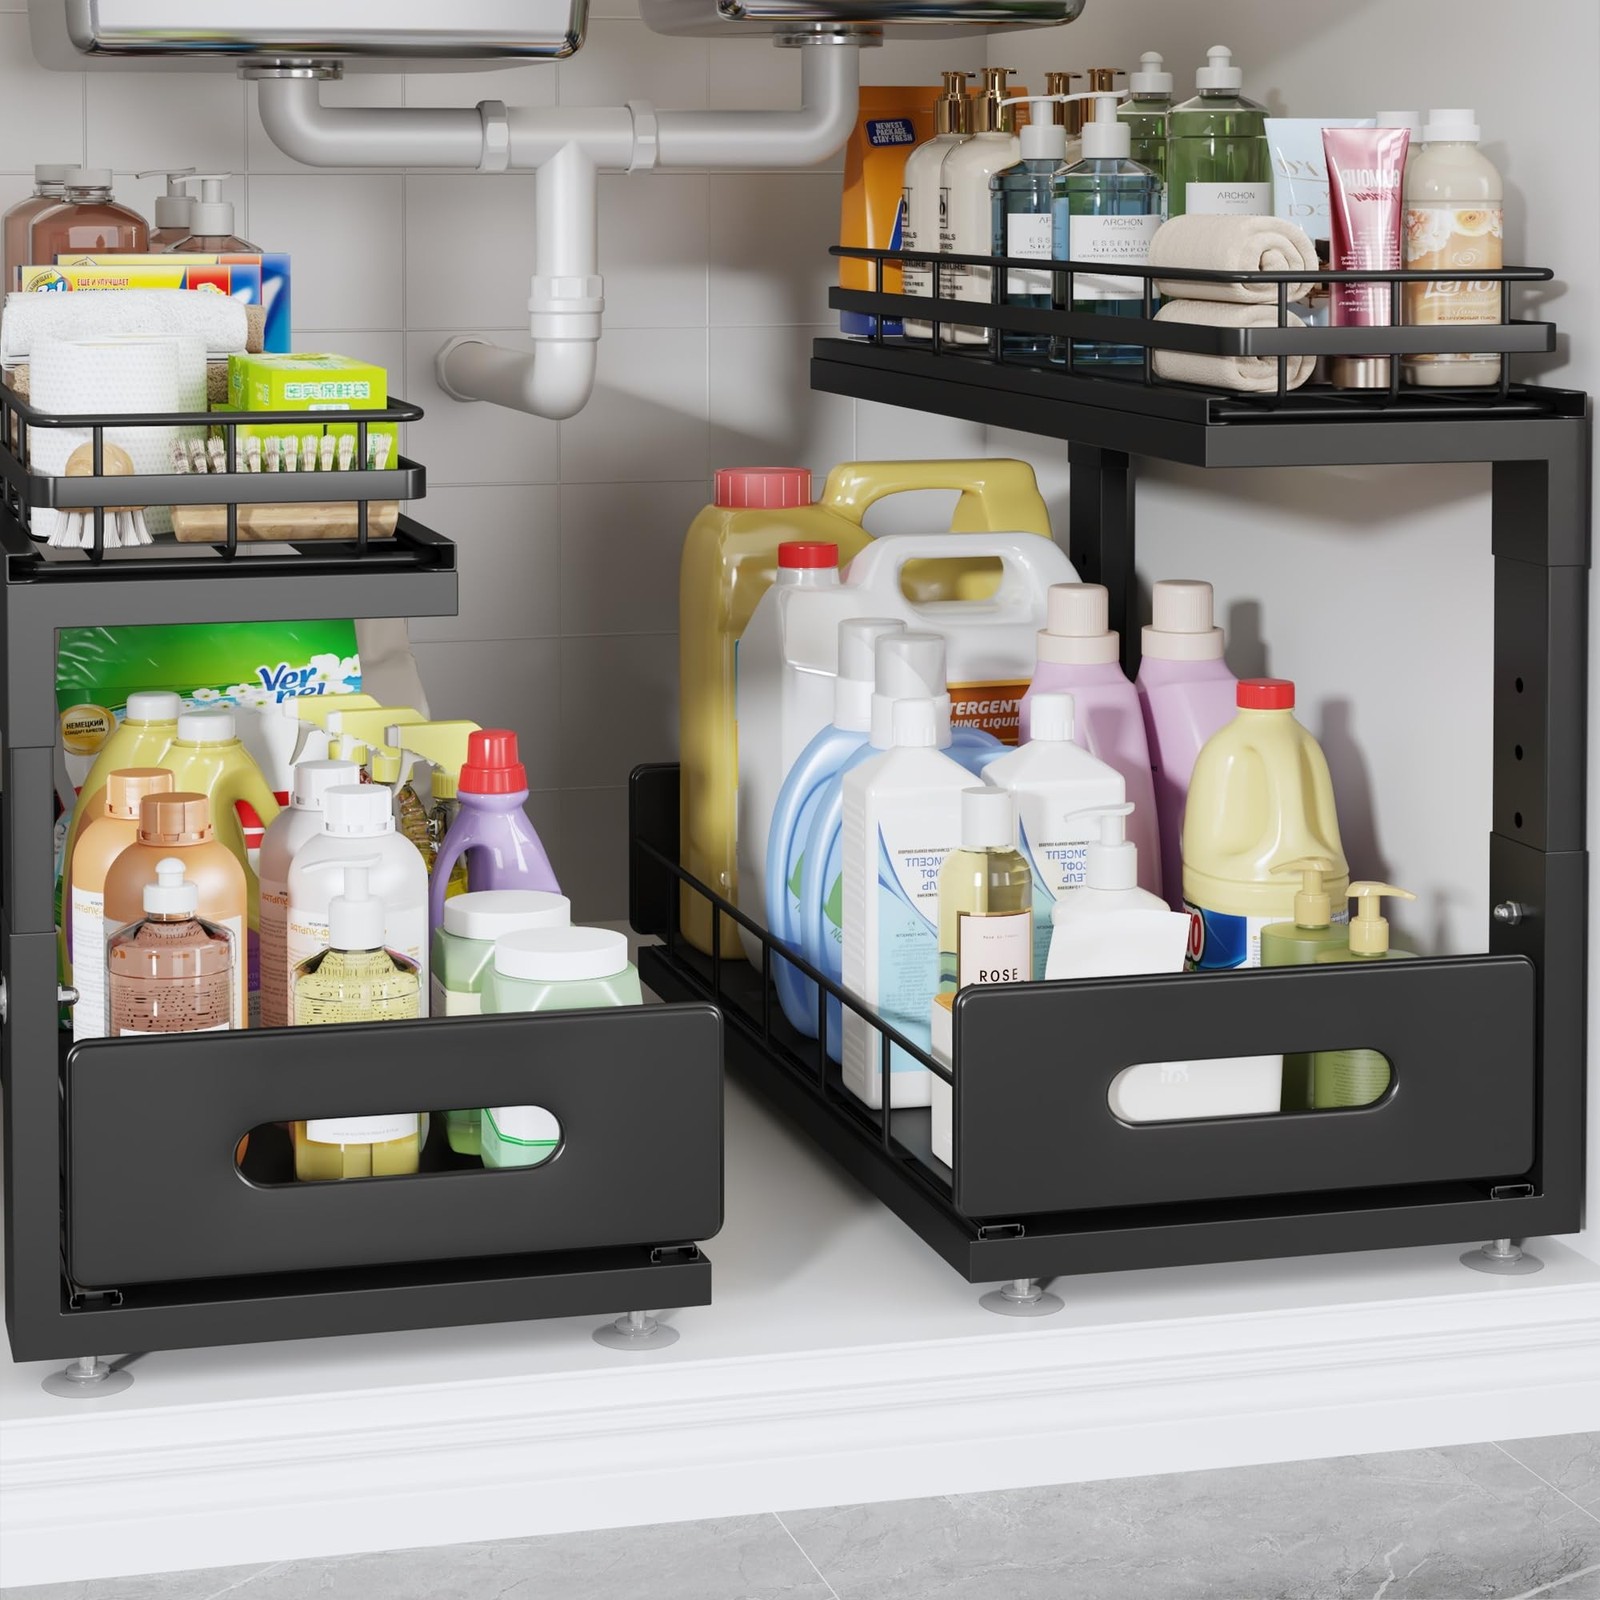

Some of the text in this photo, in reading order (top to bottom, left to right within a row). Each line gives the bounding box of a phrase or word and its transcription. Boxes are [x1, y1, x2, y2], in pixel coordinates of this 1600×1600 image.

[875, 121, 903, 129] NEWEST
[875, 128, 906, 136] PACKAGE
[872, 134, 913, 144] STAY-FRESH
[1217, 191, 1255, 200] ARCHON
[1102, 218, 1143, 226] ARCHON
[259, 665, 317, 691] Ver
[950, 699, 1021, 715] TERGENT
[66, 718, 104, 729] НЕМЕЦКИЙ
[979, 967, 1018, 982] ROSE
